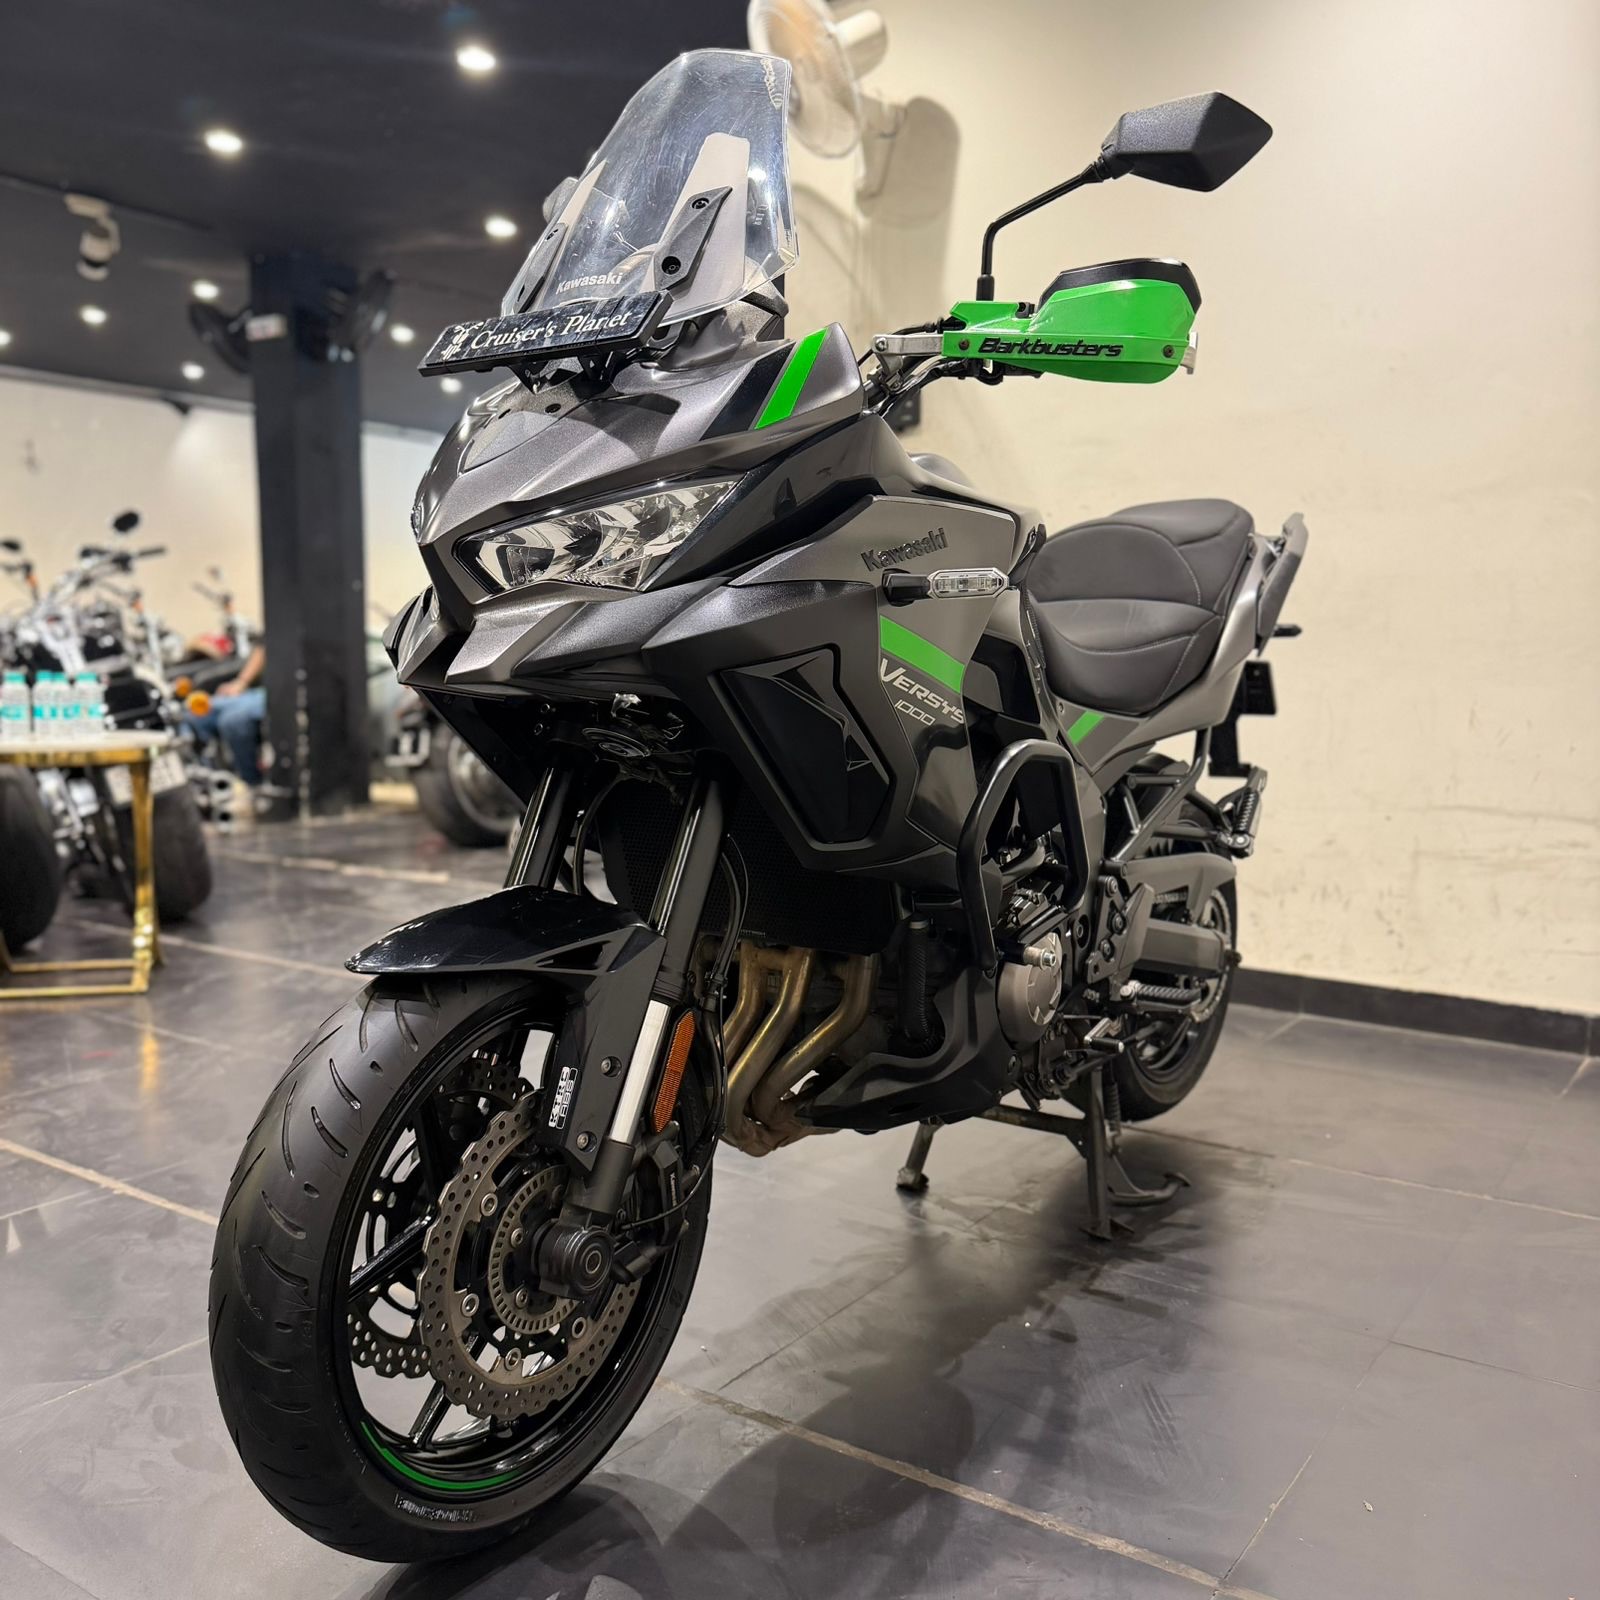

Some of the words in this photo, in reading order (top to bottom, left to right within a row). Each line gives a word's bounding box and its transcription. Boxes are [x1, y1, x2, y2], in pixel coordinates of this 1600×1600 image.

[555, 272, 623, 295] Kawasaki
[471, 320, 558, 349] Cruiser's
[560, 311, 632, 336] Planet
[978, 337, 1124, 357] Barkbusters
[861, 527, 948, 572] Kawasaki
[880, 658, 965, 724] VERSYS
[894, 699, 936, 726] 1000
